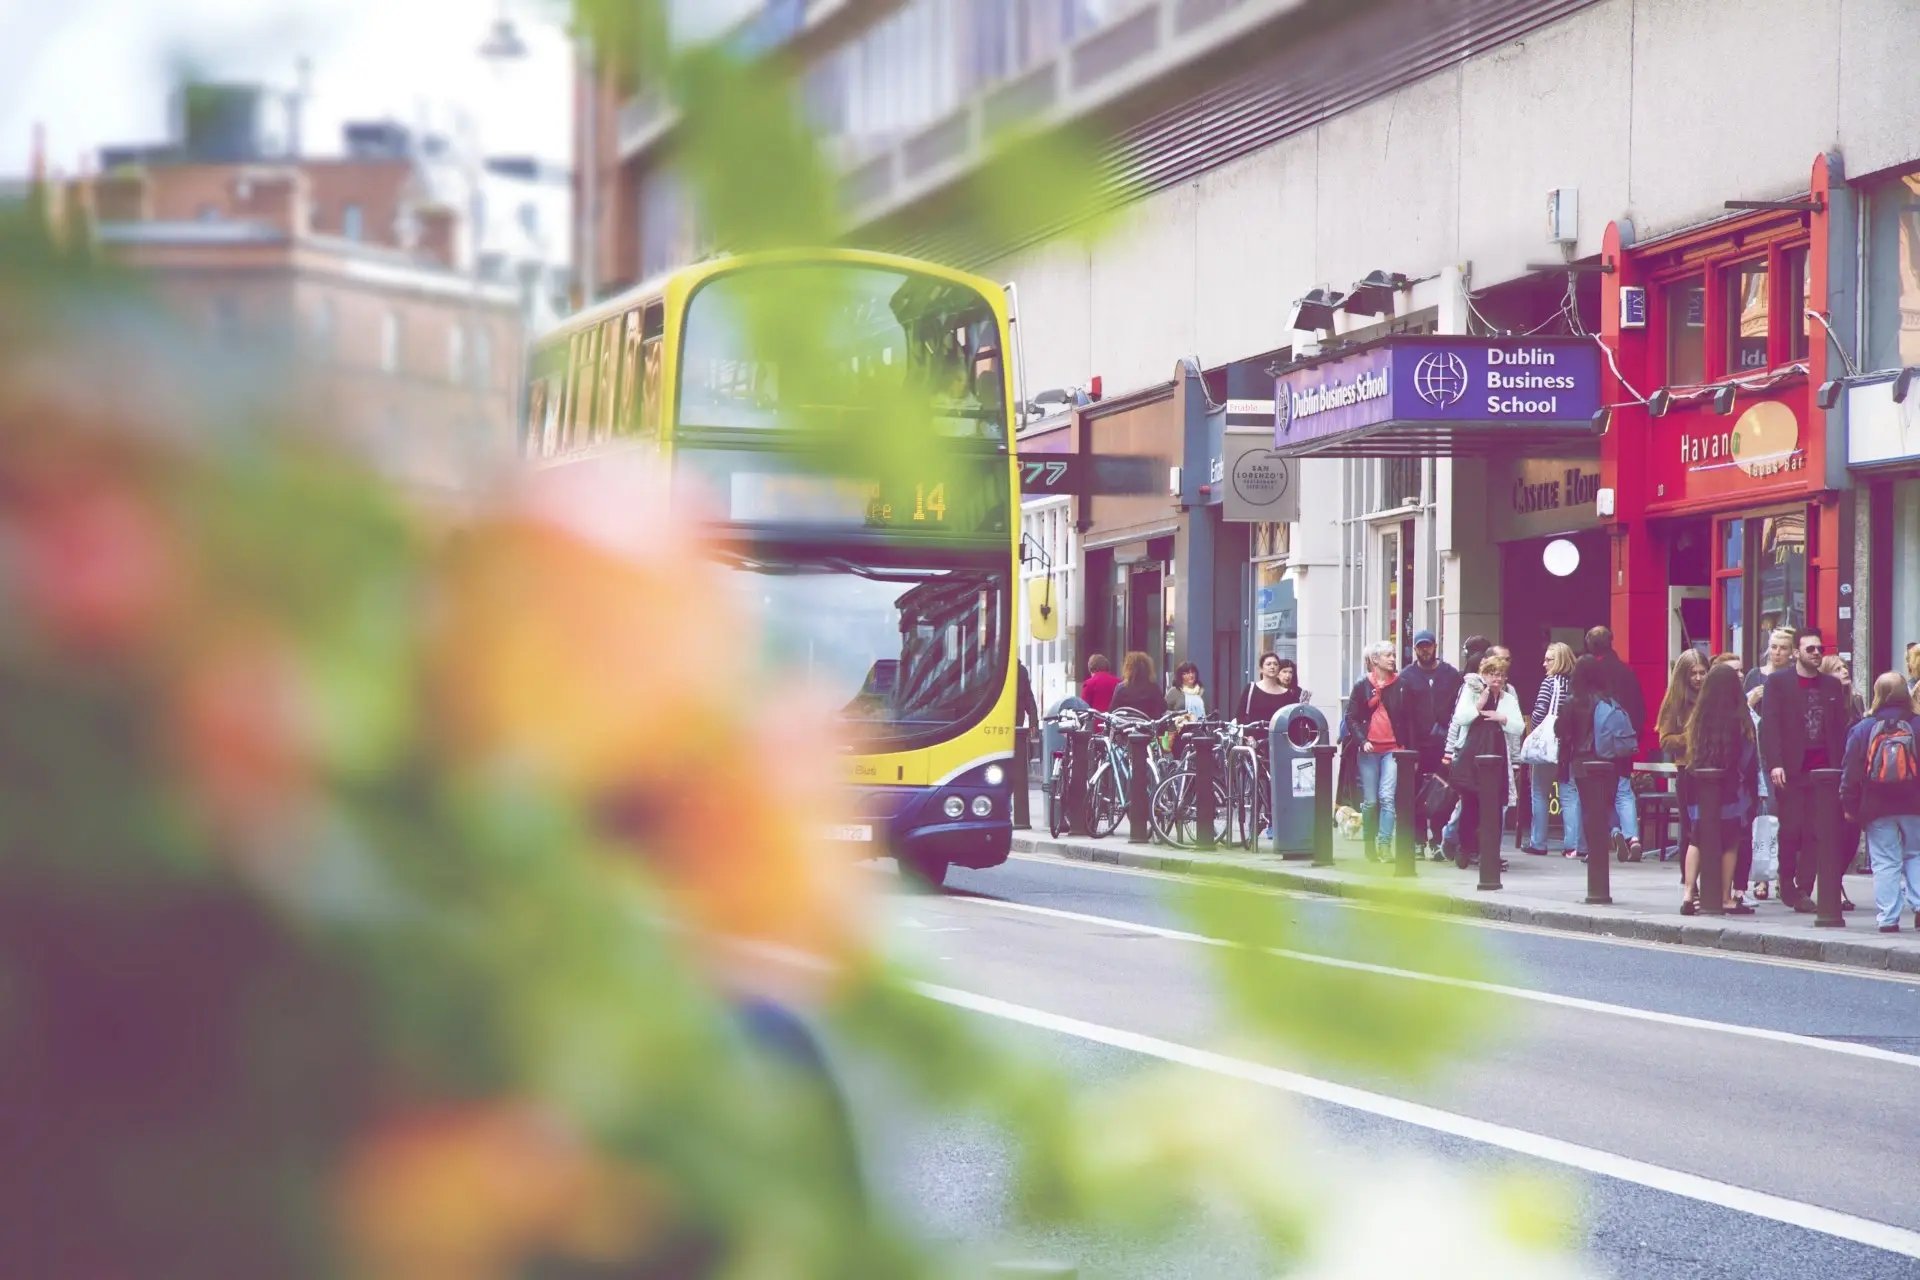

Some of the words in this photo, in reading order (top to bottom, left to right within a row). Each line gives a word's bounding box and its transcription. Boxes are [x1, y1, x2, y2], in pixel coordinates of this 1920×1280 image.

[1487, 347, 1555, 365] Dublin
[1487, 371, 1575, 389] Business
[1292, 387, 1319, 420] Dublin
[1320, 379, 1356, 411] Business
[1356, 367, 1388, 402] School
[1487, 395, 1557, 413] School
[1784, 457, 1803, 472] Bar
[914, 481, 947, 521] 14
